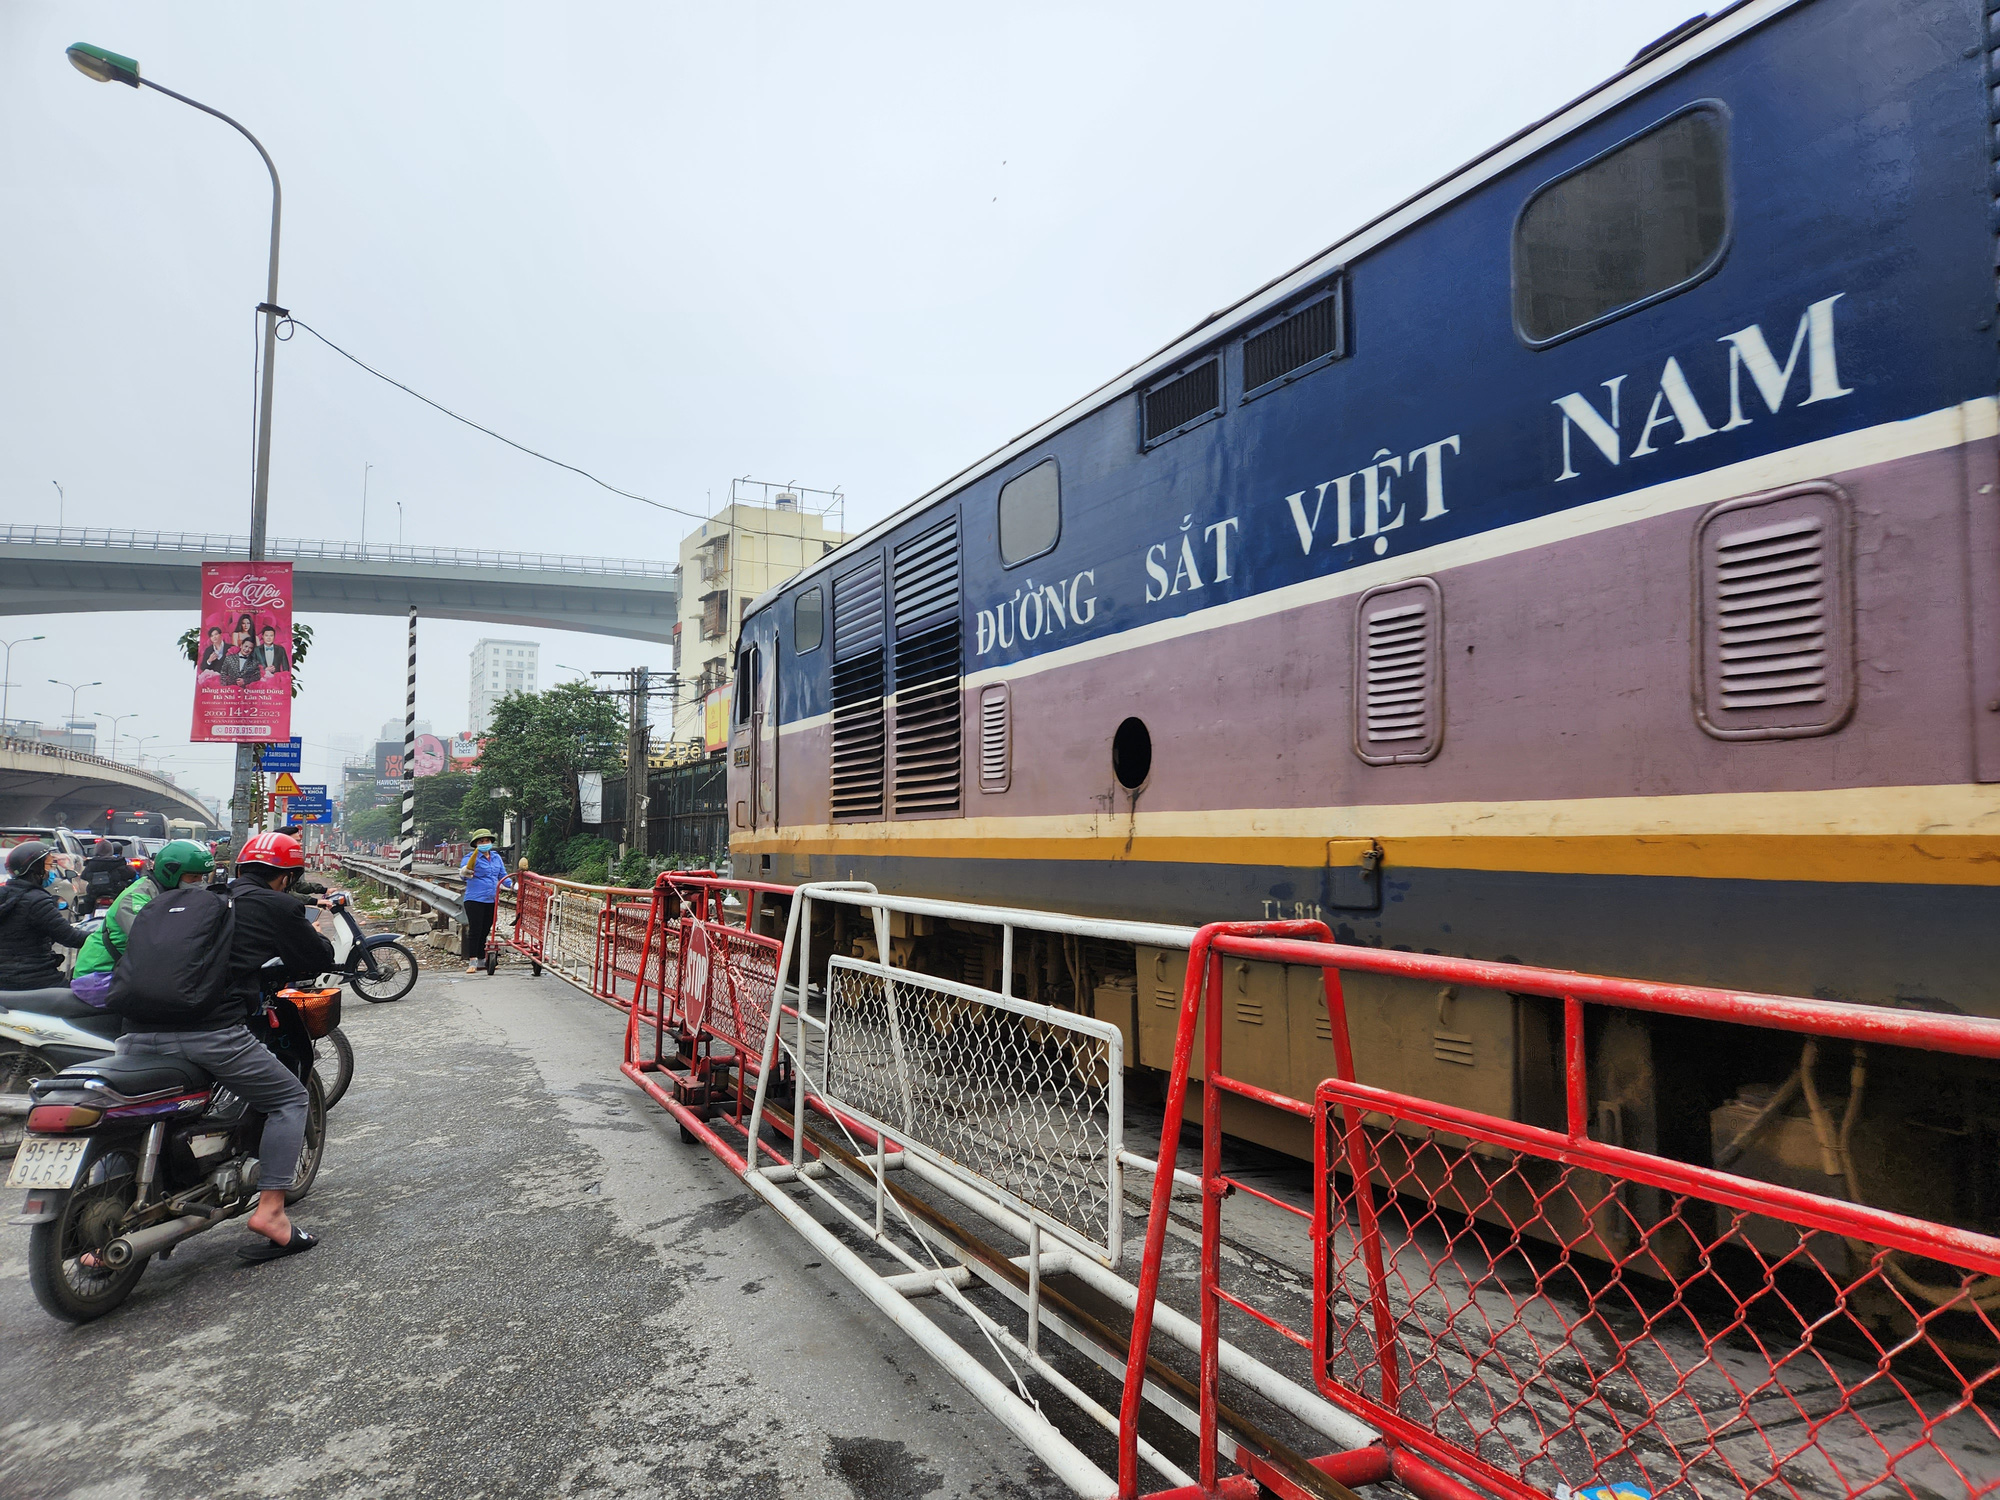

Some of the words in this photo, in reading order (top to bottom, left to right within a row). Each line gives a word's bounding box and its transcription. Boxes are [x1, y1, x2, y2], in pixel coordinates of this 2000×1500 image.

[974, 568, 1097, 656] ĐƯỜNG
[1144, 514, 1240, 604] SẮT
[1285, 434, 1461, 556] VIỆT
[1551, 292, 1855, 482] NAM
[242, 583, 285, 608] Yêu
[229, 707, 242, 716] 14
[249, 707, 258, 716] 2
[686, 948, 707, 1002] STOP
